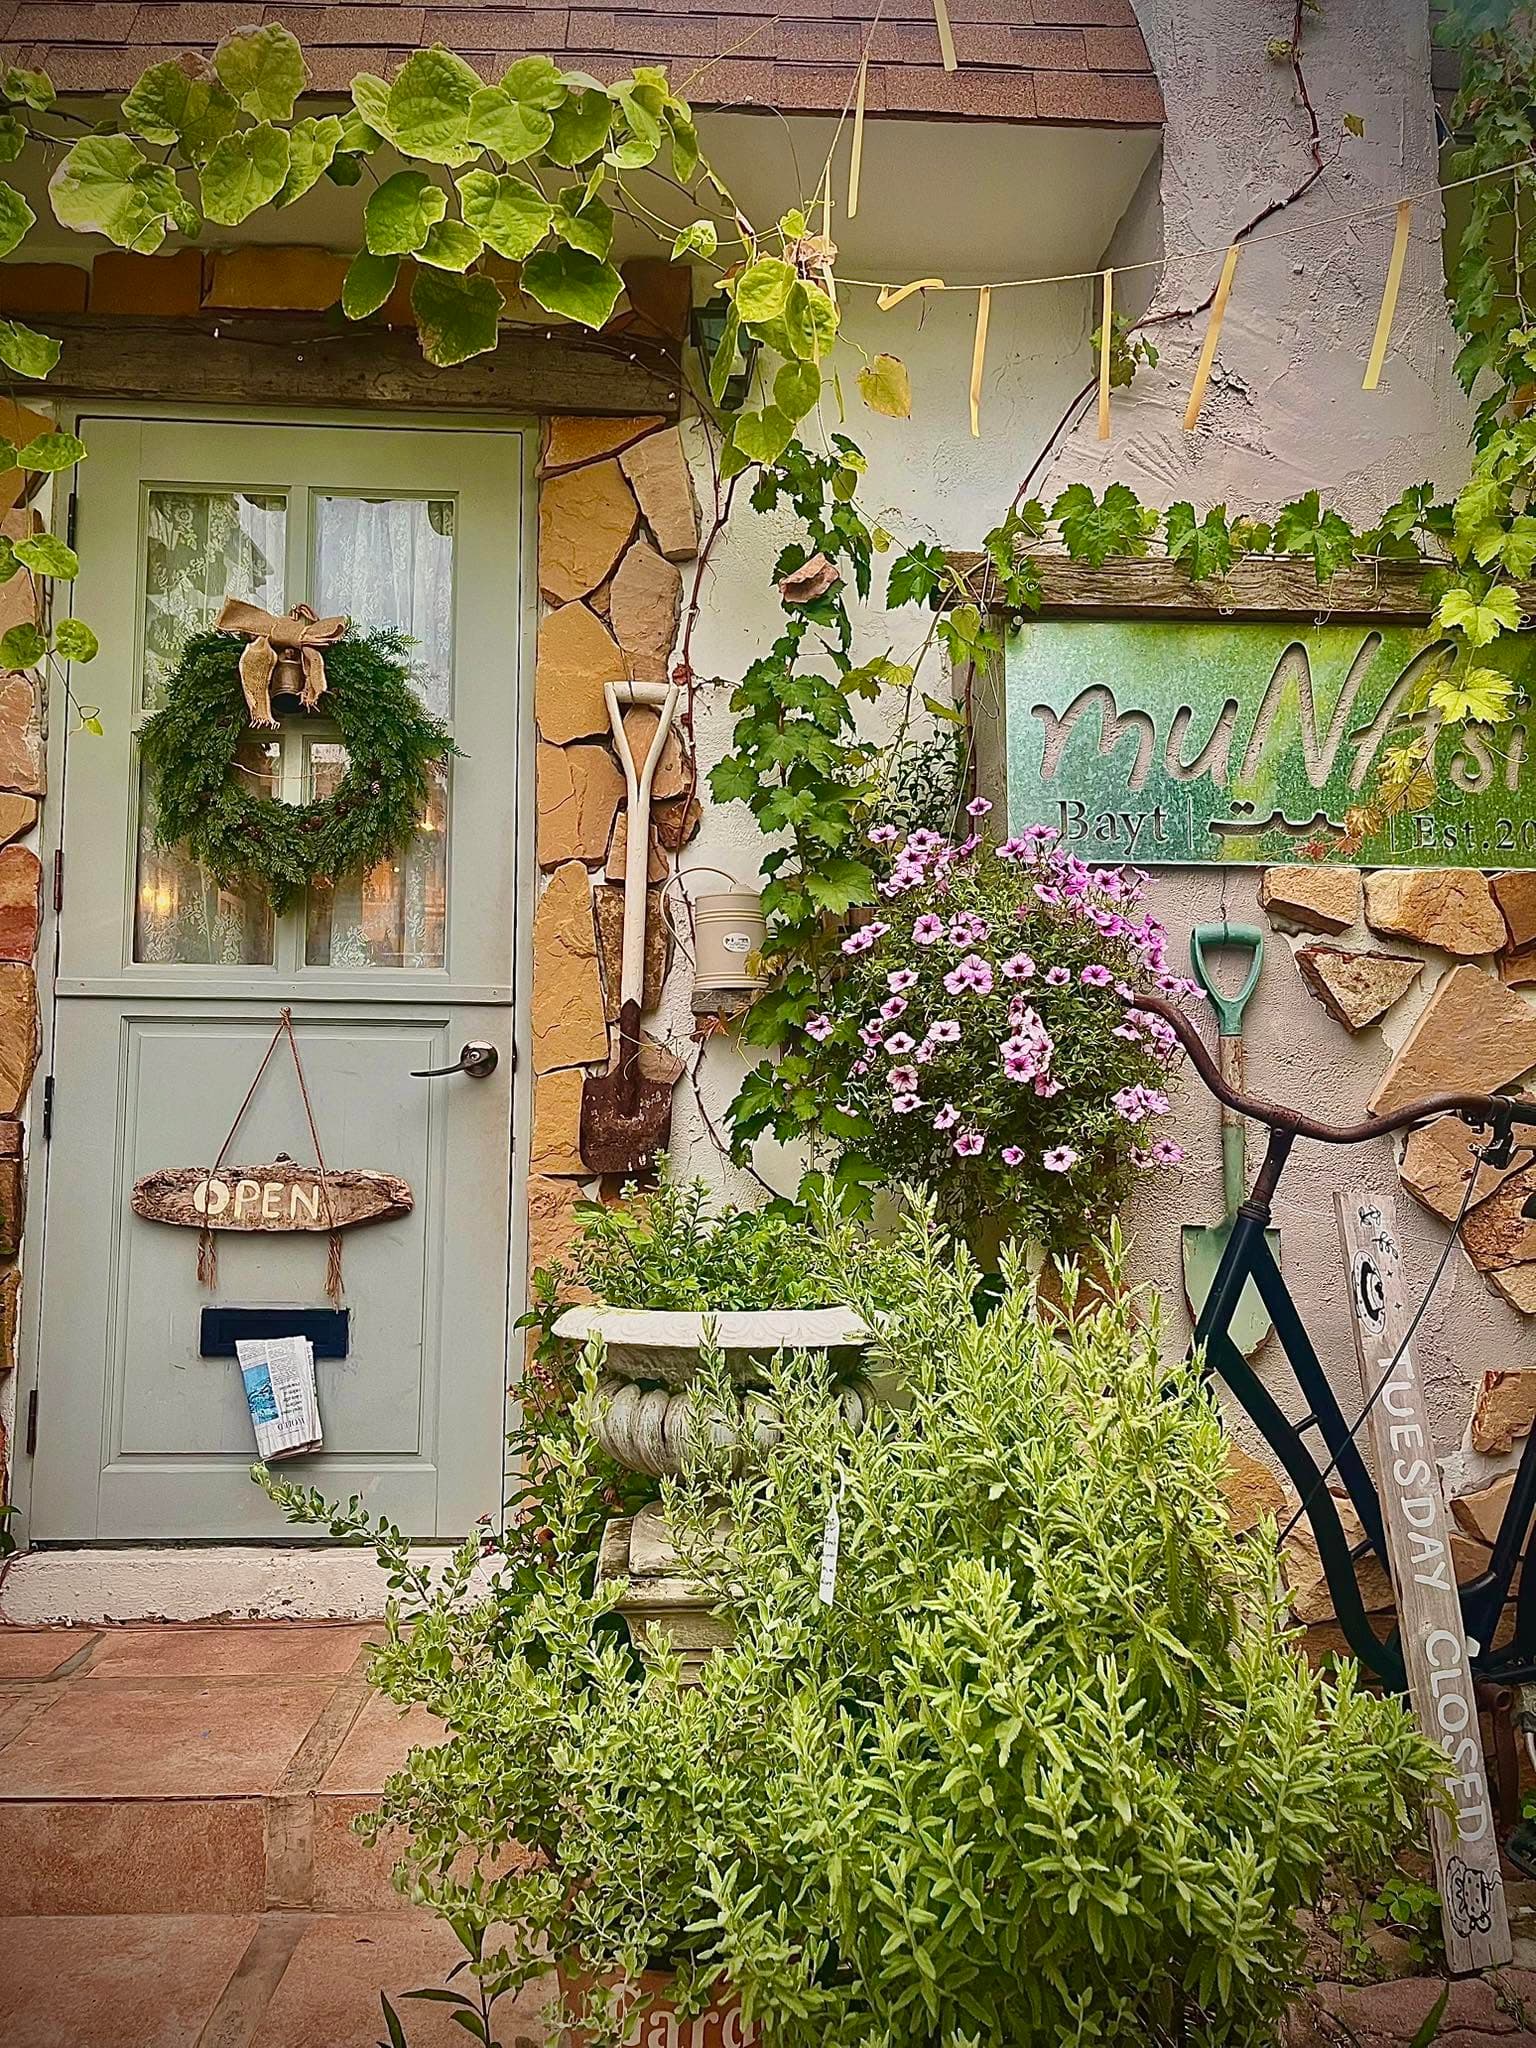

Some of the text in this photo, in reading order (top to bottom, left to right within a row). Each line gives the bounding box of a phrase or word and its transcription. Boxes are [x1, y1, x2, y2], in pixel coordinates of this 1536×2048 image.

[1056, 800, 1170, 856] Bayt
[192, 1179, 321, 1220] OPEN
[1377, 1345, 1489, 1843] TUESDAY CLOSED
